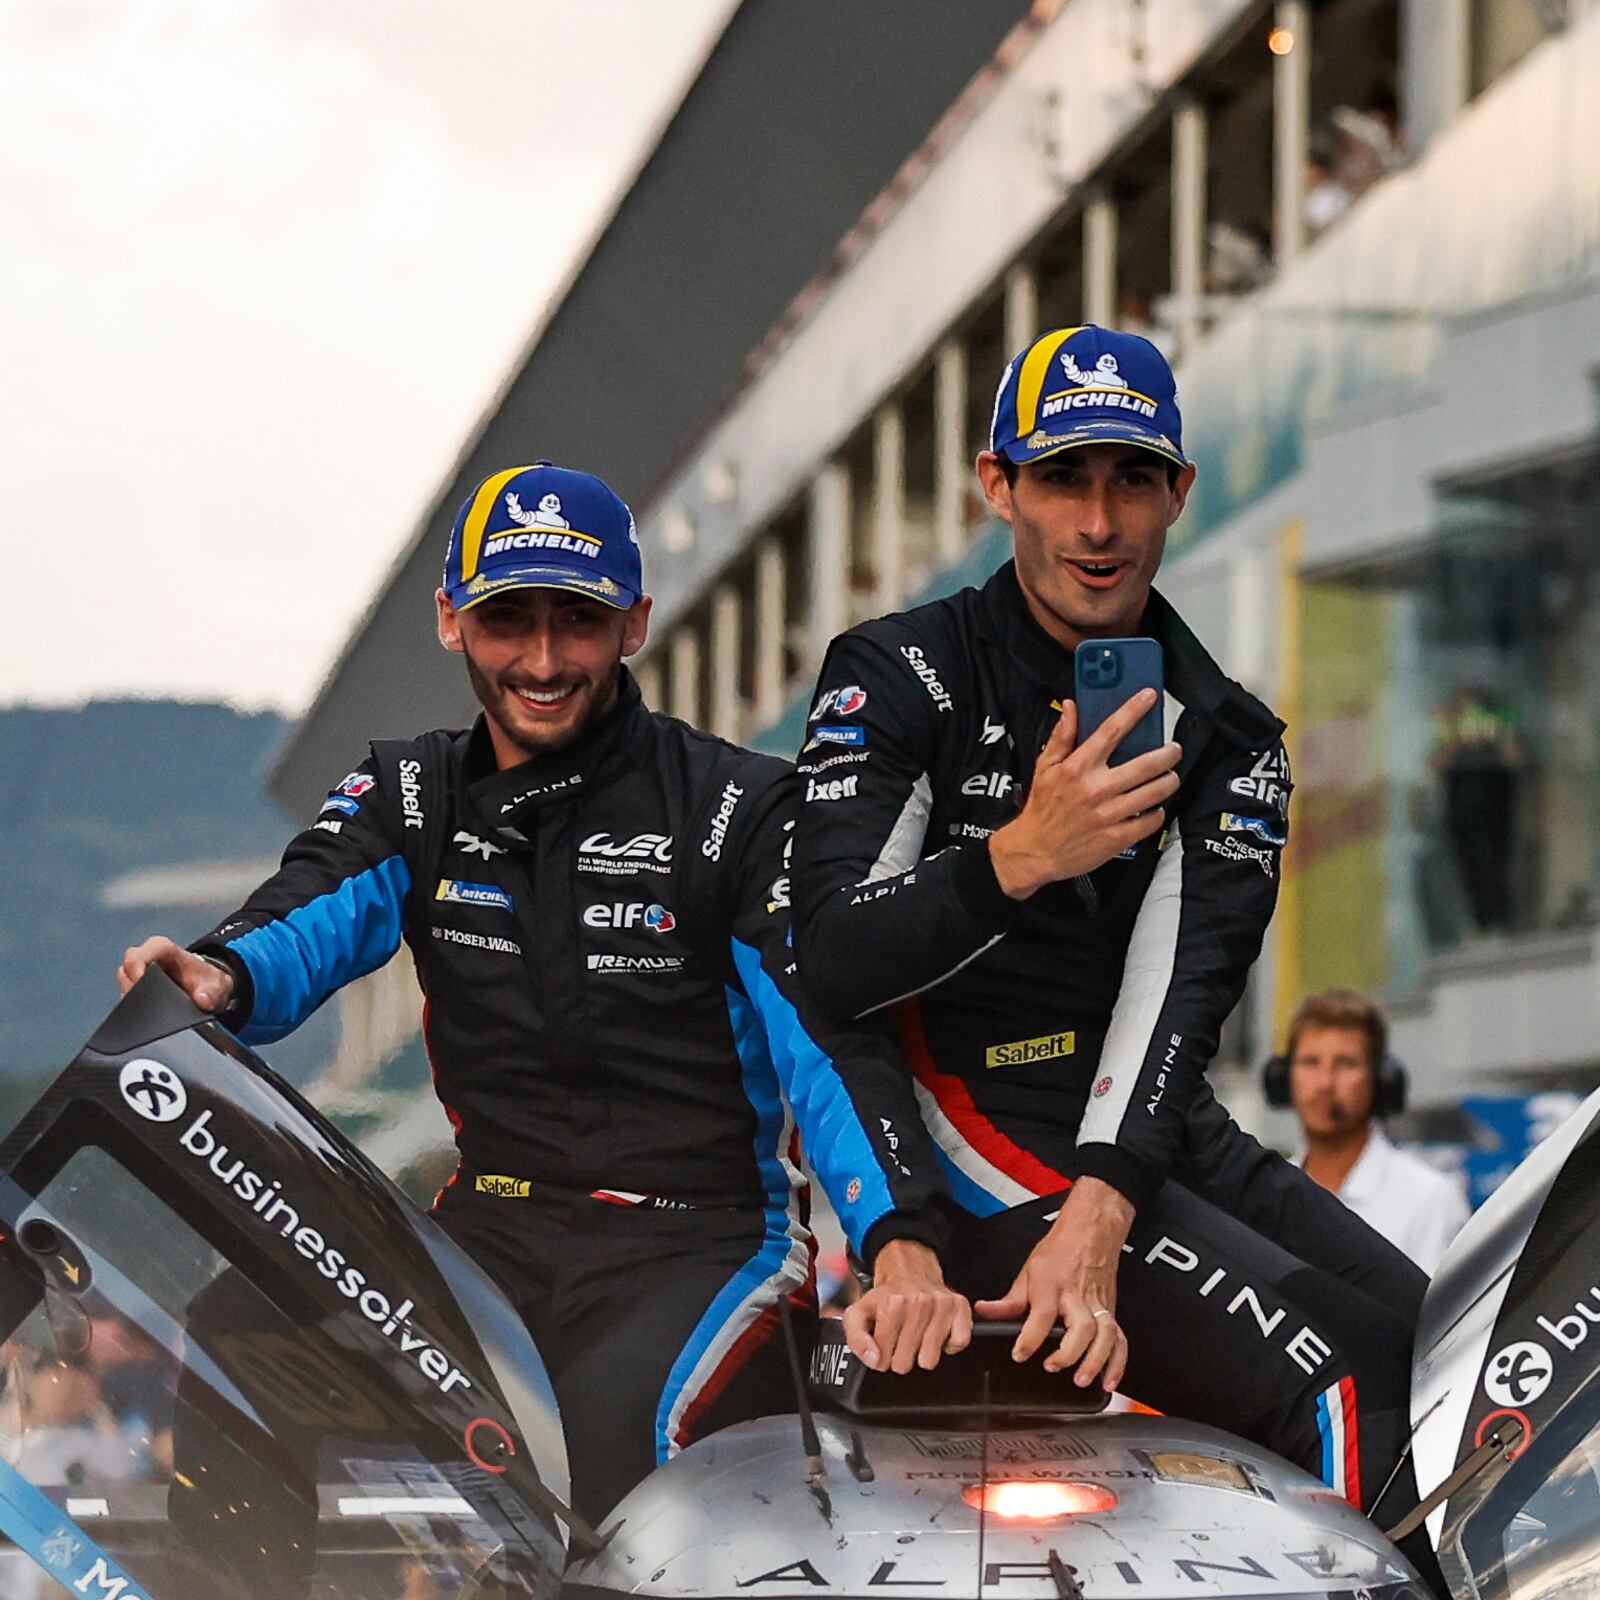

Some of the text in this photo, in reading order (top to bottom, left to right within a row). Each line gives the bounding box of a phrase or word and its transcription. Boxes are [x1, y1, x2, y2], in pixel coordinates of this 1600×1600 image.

[1041, 393, 1158, 418] MICHELIN
[484, 533, 601, 558] MICHELIN
[900, 645, 953, 712] Sabelt
[399, 759, 425, 830] Sabelt
[962, 772, 1013, 799] elf
[1229, 776, 1280, 804] elf
[701, 780, 744, 863] Sabelt
[577, 864, 639, 875] CHAMPIONSHIP
[850, 873, 916, 906] ALPIE
[583, 903, 644, 928] elf
[444, 930, 522, 955] MOSER.WATC
[995, 1035, 1069, 1066] Sabelt
[1146, 1033, 1183, 1116] ALPINE
[480, 1177, 522, 1195] Sabelt
[180, 1110, 473, 1397] businessolver
[809, 1344, 852, 1386] ALPINE
[737, 1550, 1365, 1587] ALPINE
